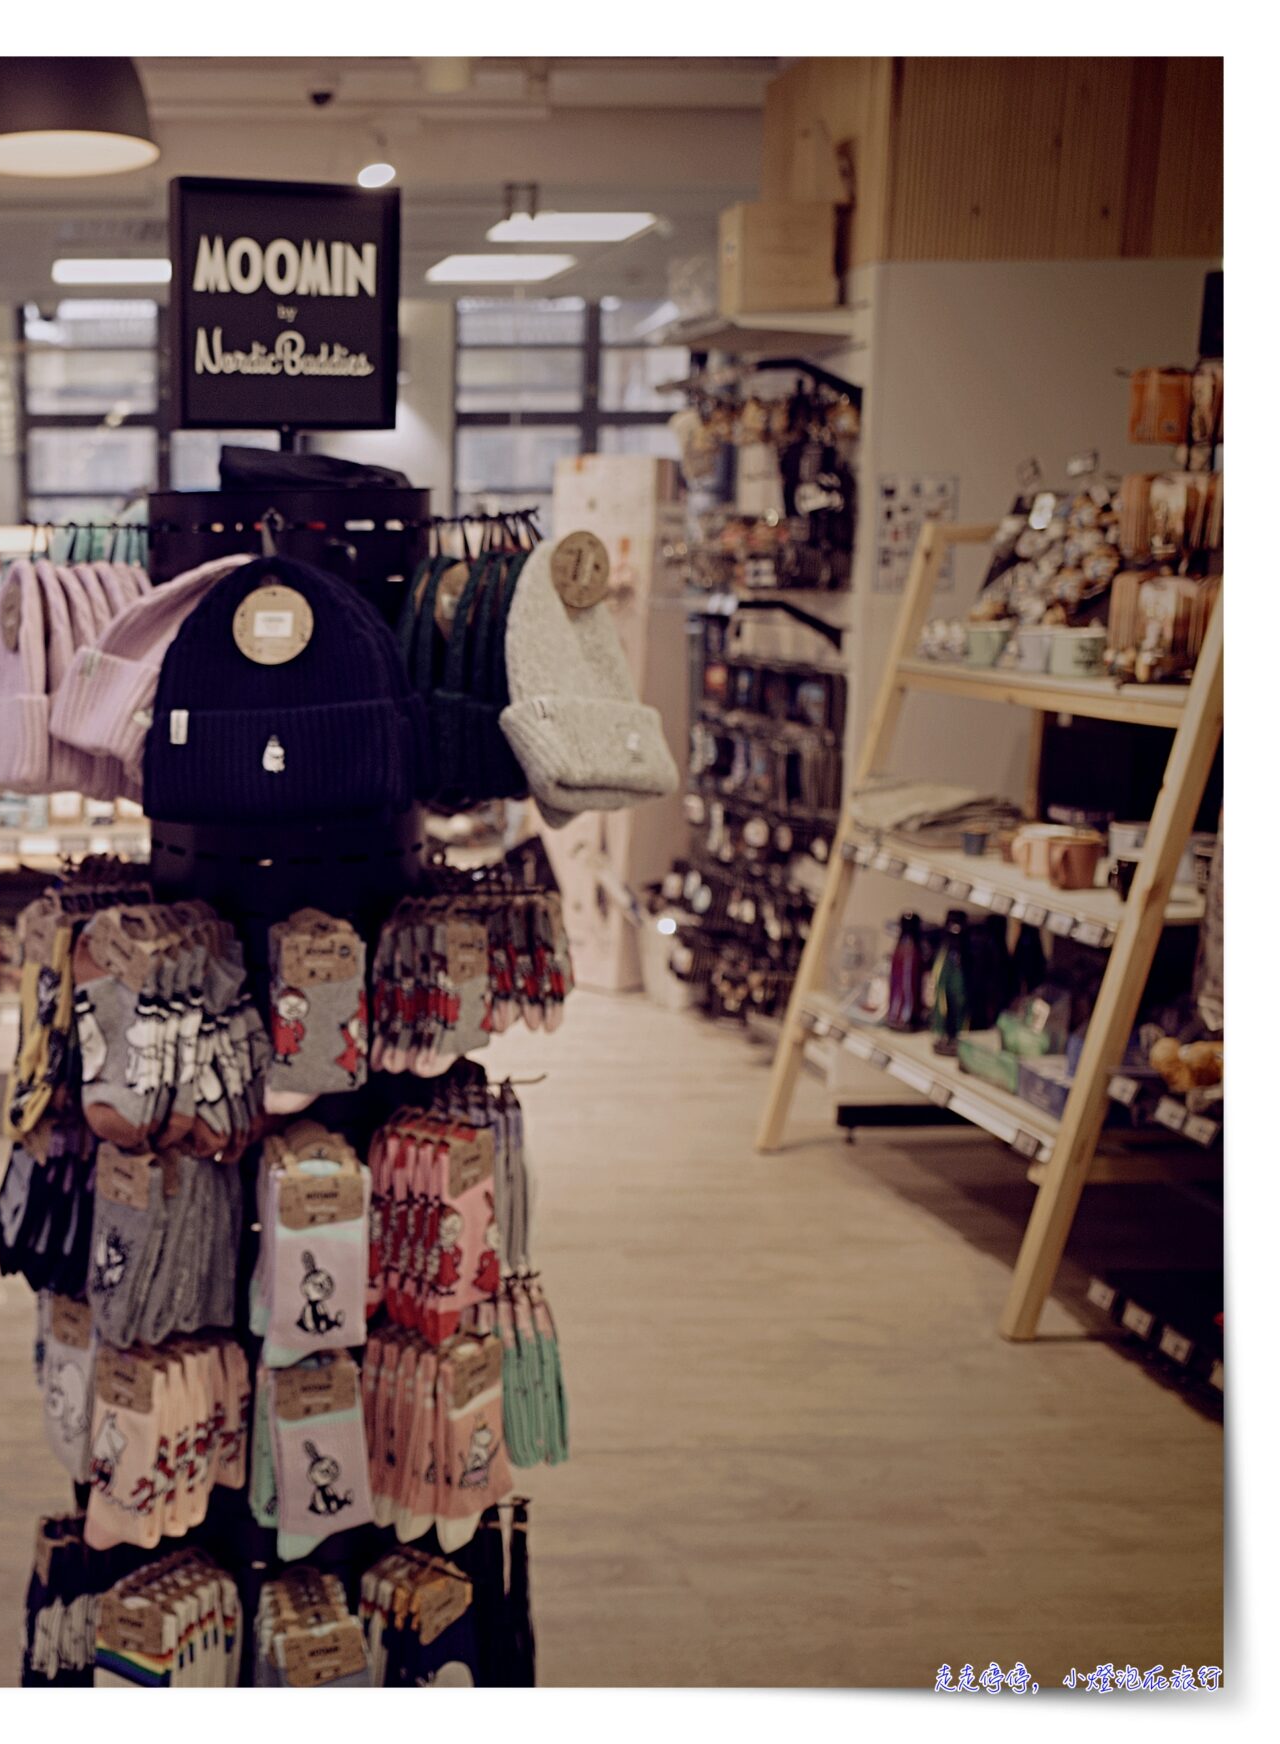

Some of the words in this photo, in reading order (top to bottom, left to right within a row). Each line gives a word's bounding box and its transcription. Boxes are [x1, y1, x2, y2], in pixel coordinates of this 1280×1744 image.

[193, 234, 376, 297] MOOMIN
[276, 303, 298, 323] by
[195, 326, 282, 375] Nordic
[275, 330, 375, 377] Buddies
